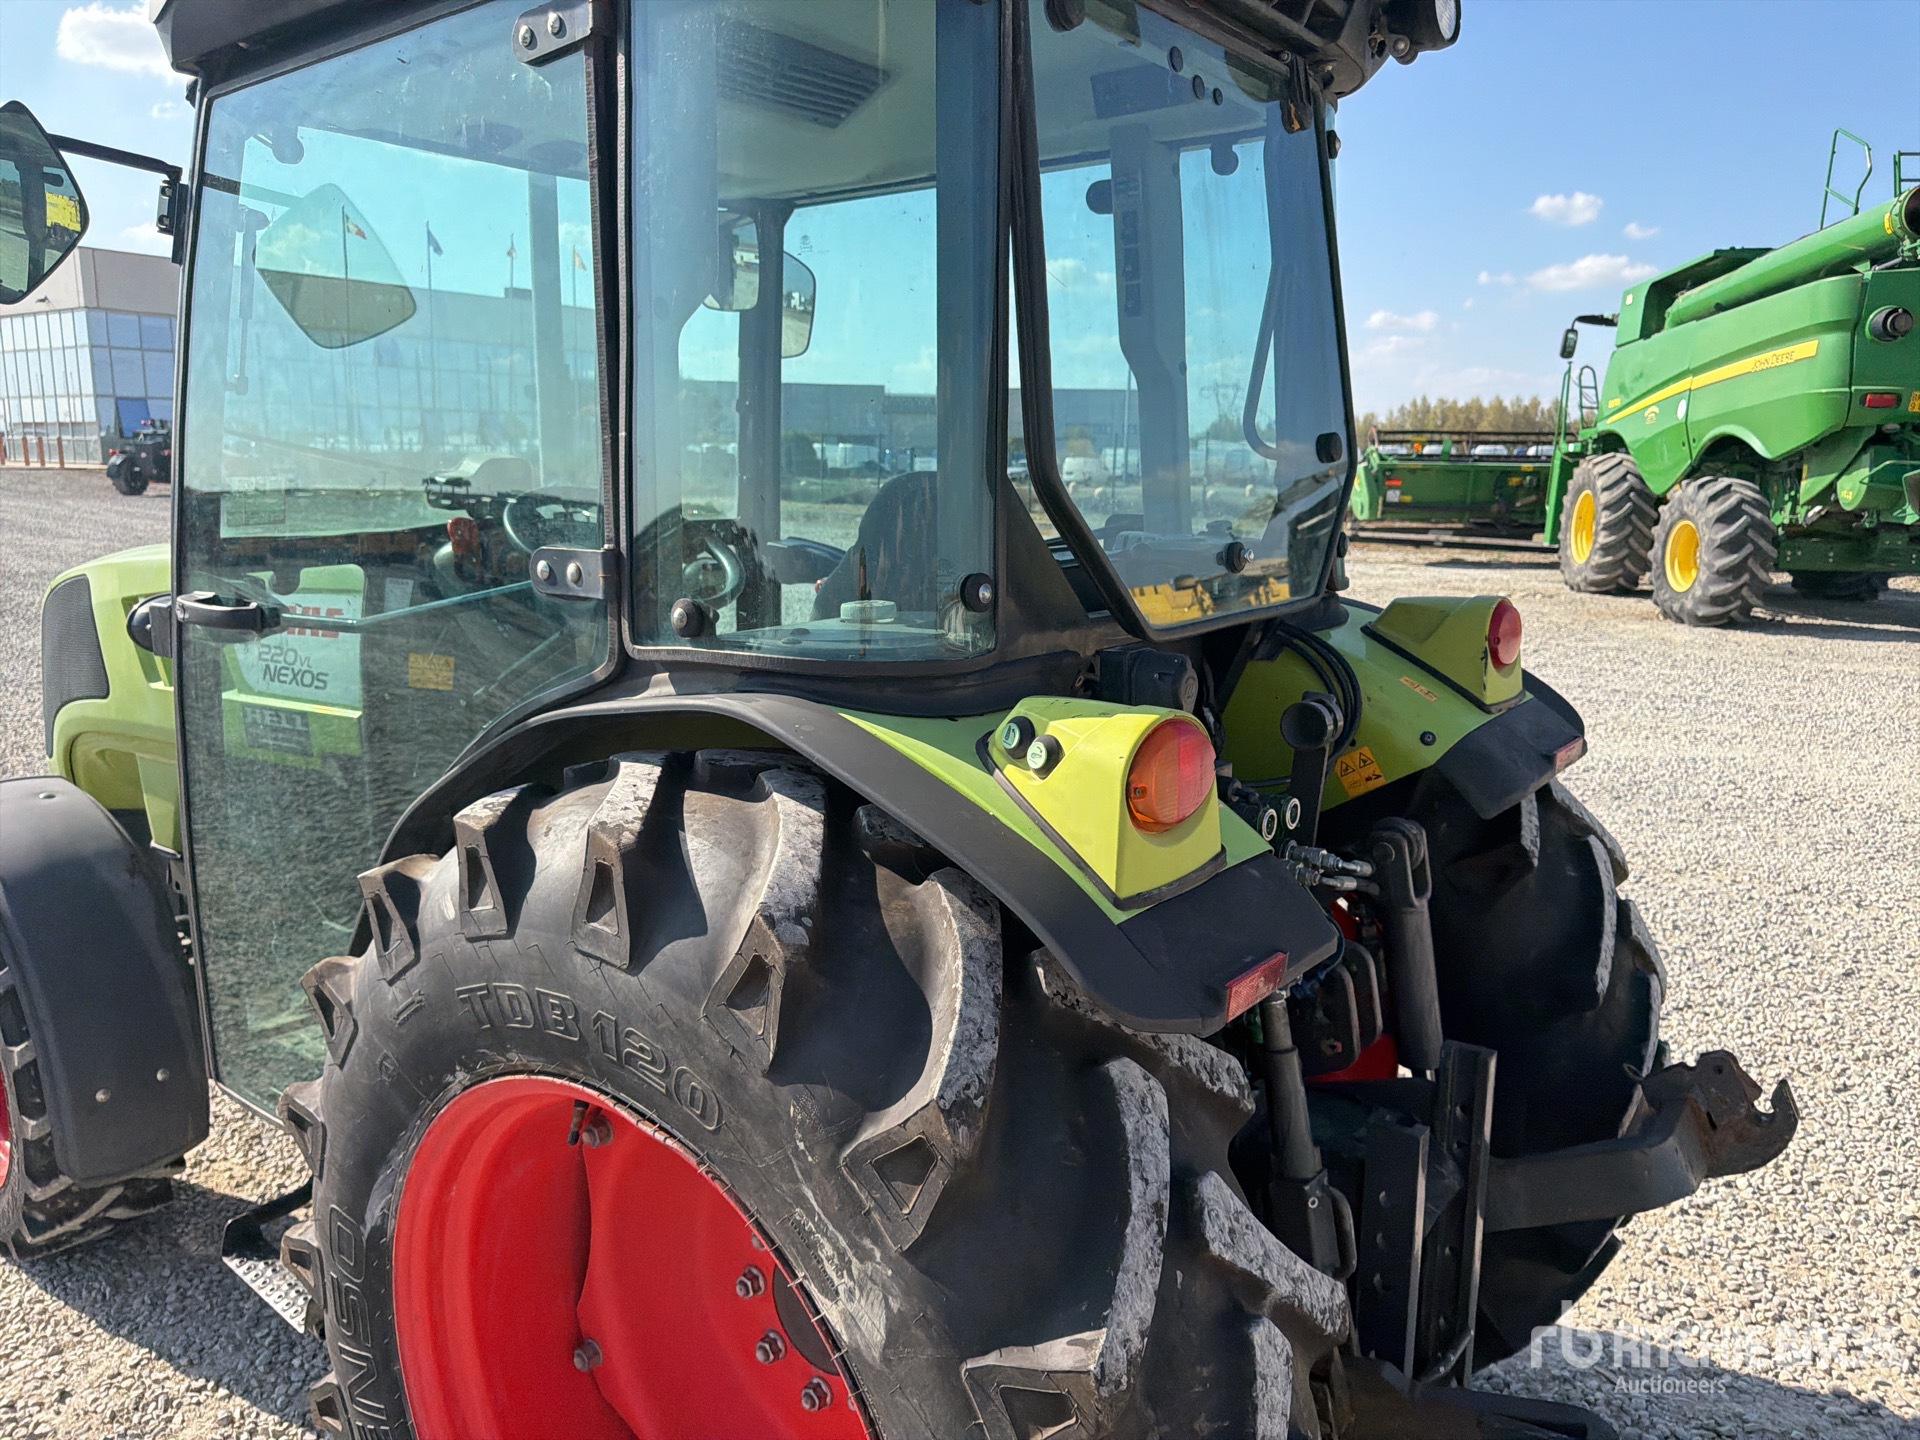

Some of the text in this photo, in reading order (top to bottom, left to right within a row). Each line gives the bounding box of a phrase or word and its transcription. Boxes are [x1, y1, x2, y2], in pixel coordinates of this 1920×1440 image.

[1771, 350, 1795, 365] DEERE
[262, 664, 329, 690] NEXOS
[454, 982, 581, 1042] TDB
[591, 1010, 724, 1131] 120
